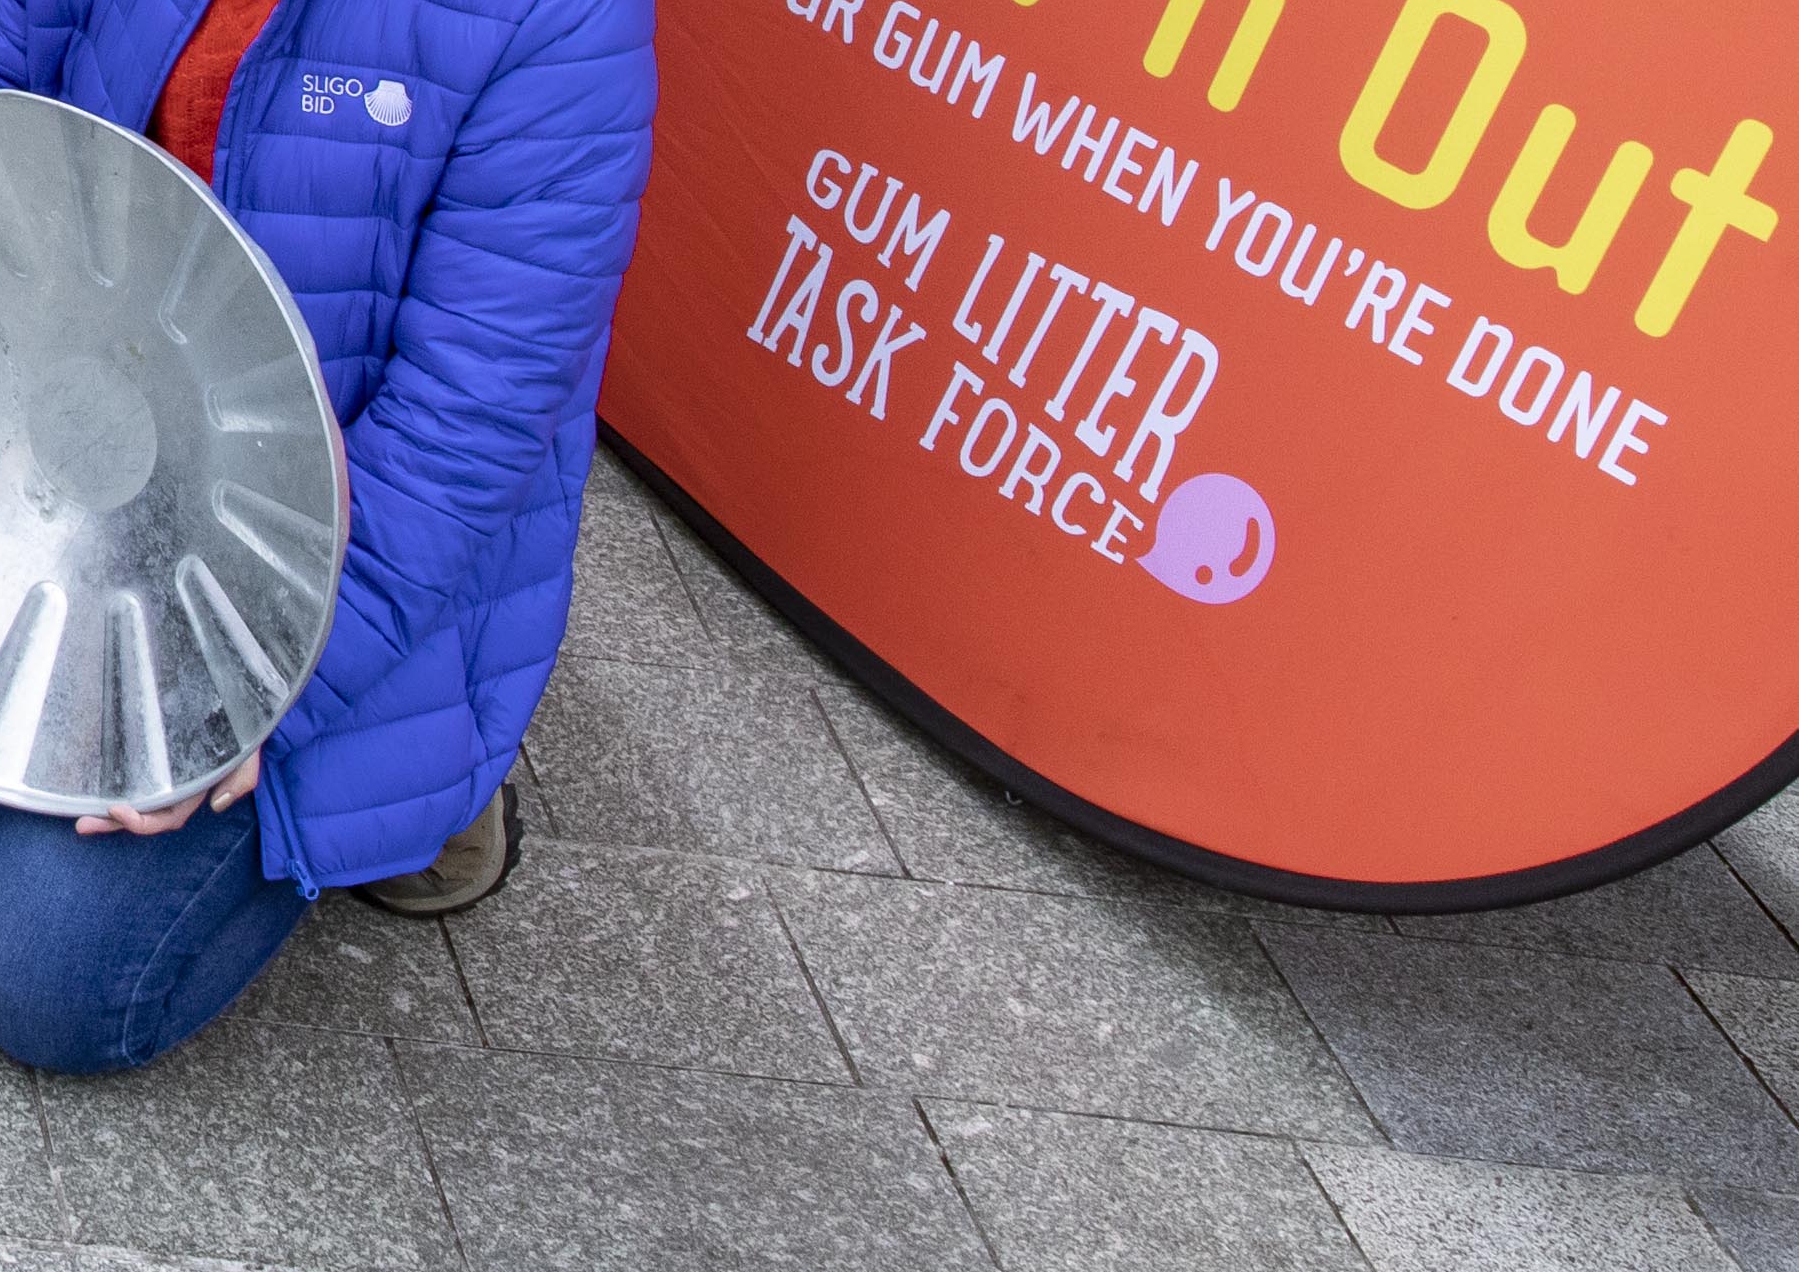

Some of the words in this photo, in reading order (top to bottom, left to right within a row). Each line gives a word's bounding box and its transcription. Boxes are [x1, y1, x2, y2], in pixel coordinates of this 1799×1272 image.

[302, 74, 363, 97] SLIGO
[302, 94, 335, 114] BID
[873, 0, 1006, 120] GUM
[1011, 71, 1200, 228] WHEN
[1205, 177, 1453, 366] YOU'RE
[1446, 316, 1669, 487] DONE
[747, 214, 928, 421] TASK
[919, 361, 1144, 565] FORCE
[806, 149, 951, 292] GUM
[952, 234, 1220, 503] LITTER
